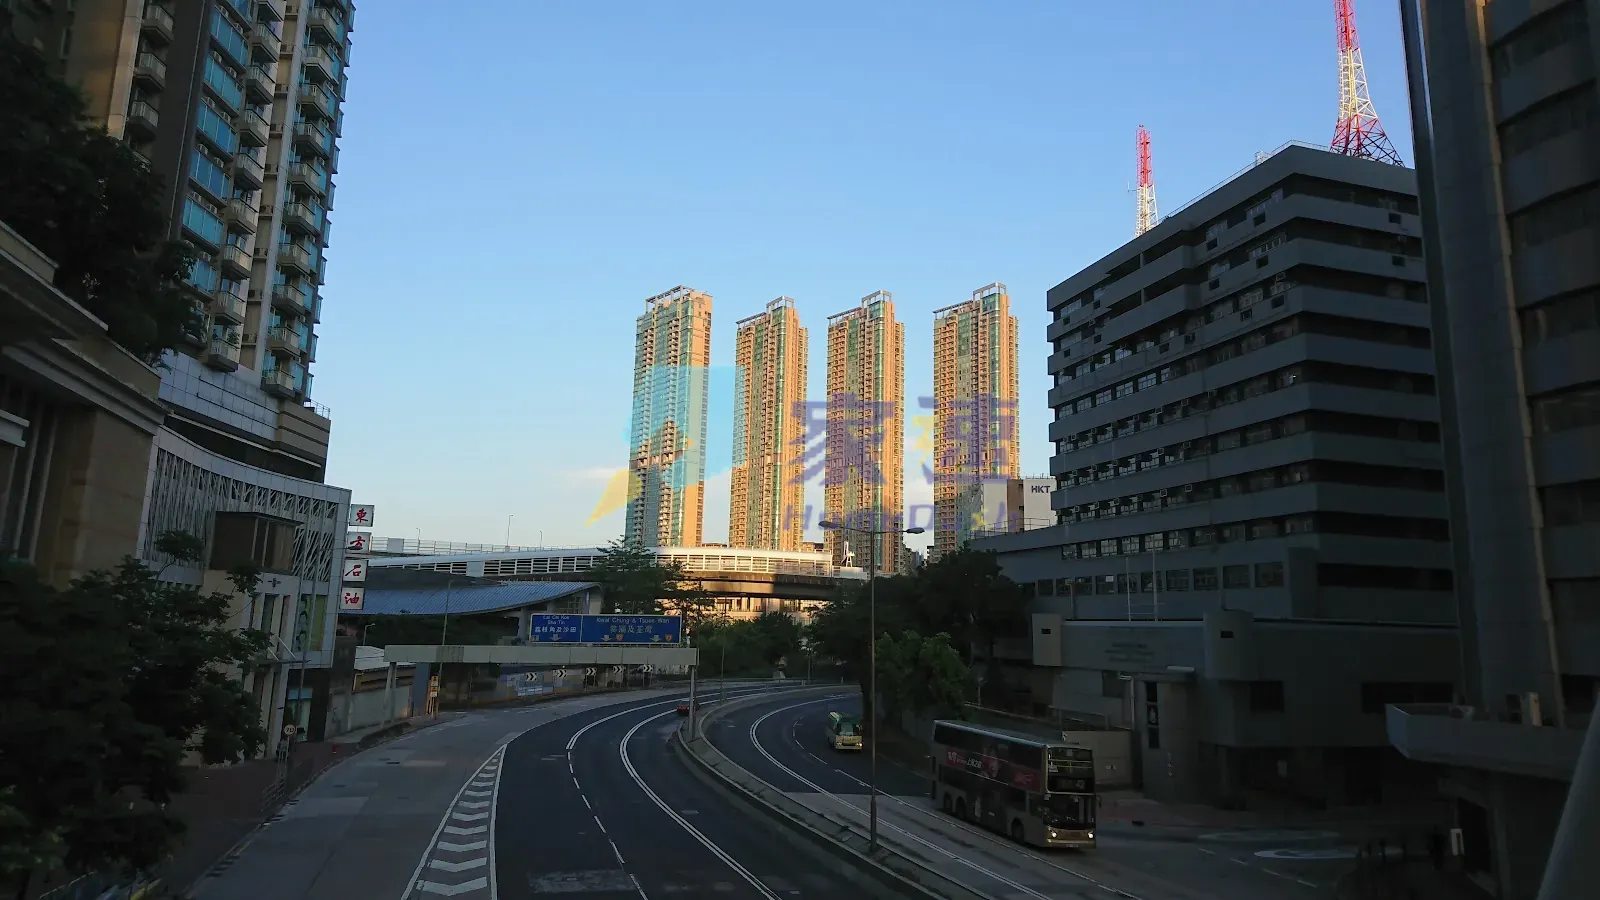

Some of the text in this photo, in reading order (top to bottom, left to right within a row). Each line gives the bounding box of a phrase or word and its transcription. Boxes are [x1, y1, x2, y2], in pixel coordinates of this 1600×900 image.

[1031, 485, 1051, 494] HKT
[343, 507, 369, 606] 東方石油
[611, 617, 630, 625] Chung
